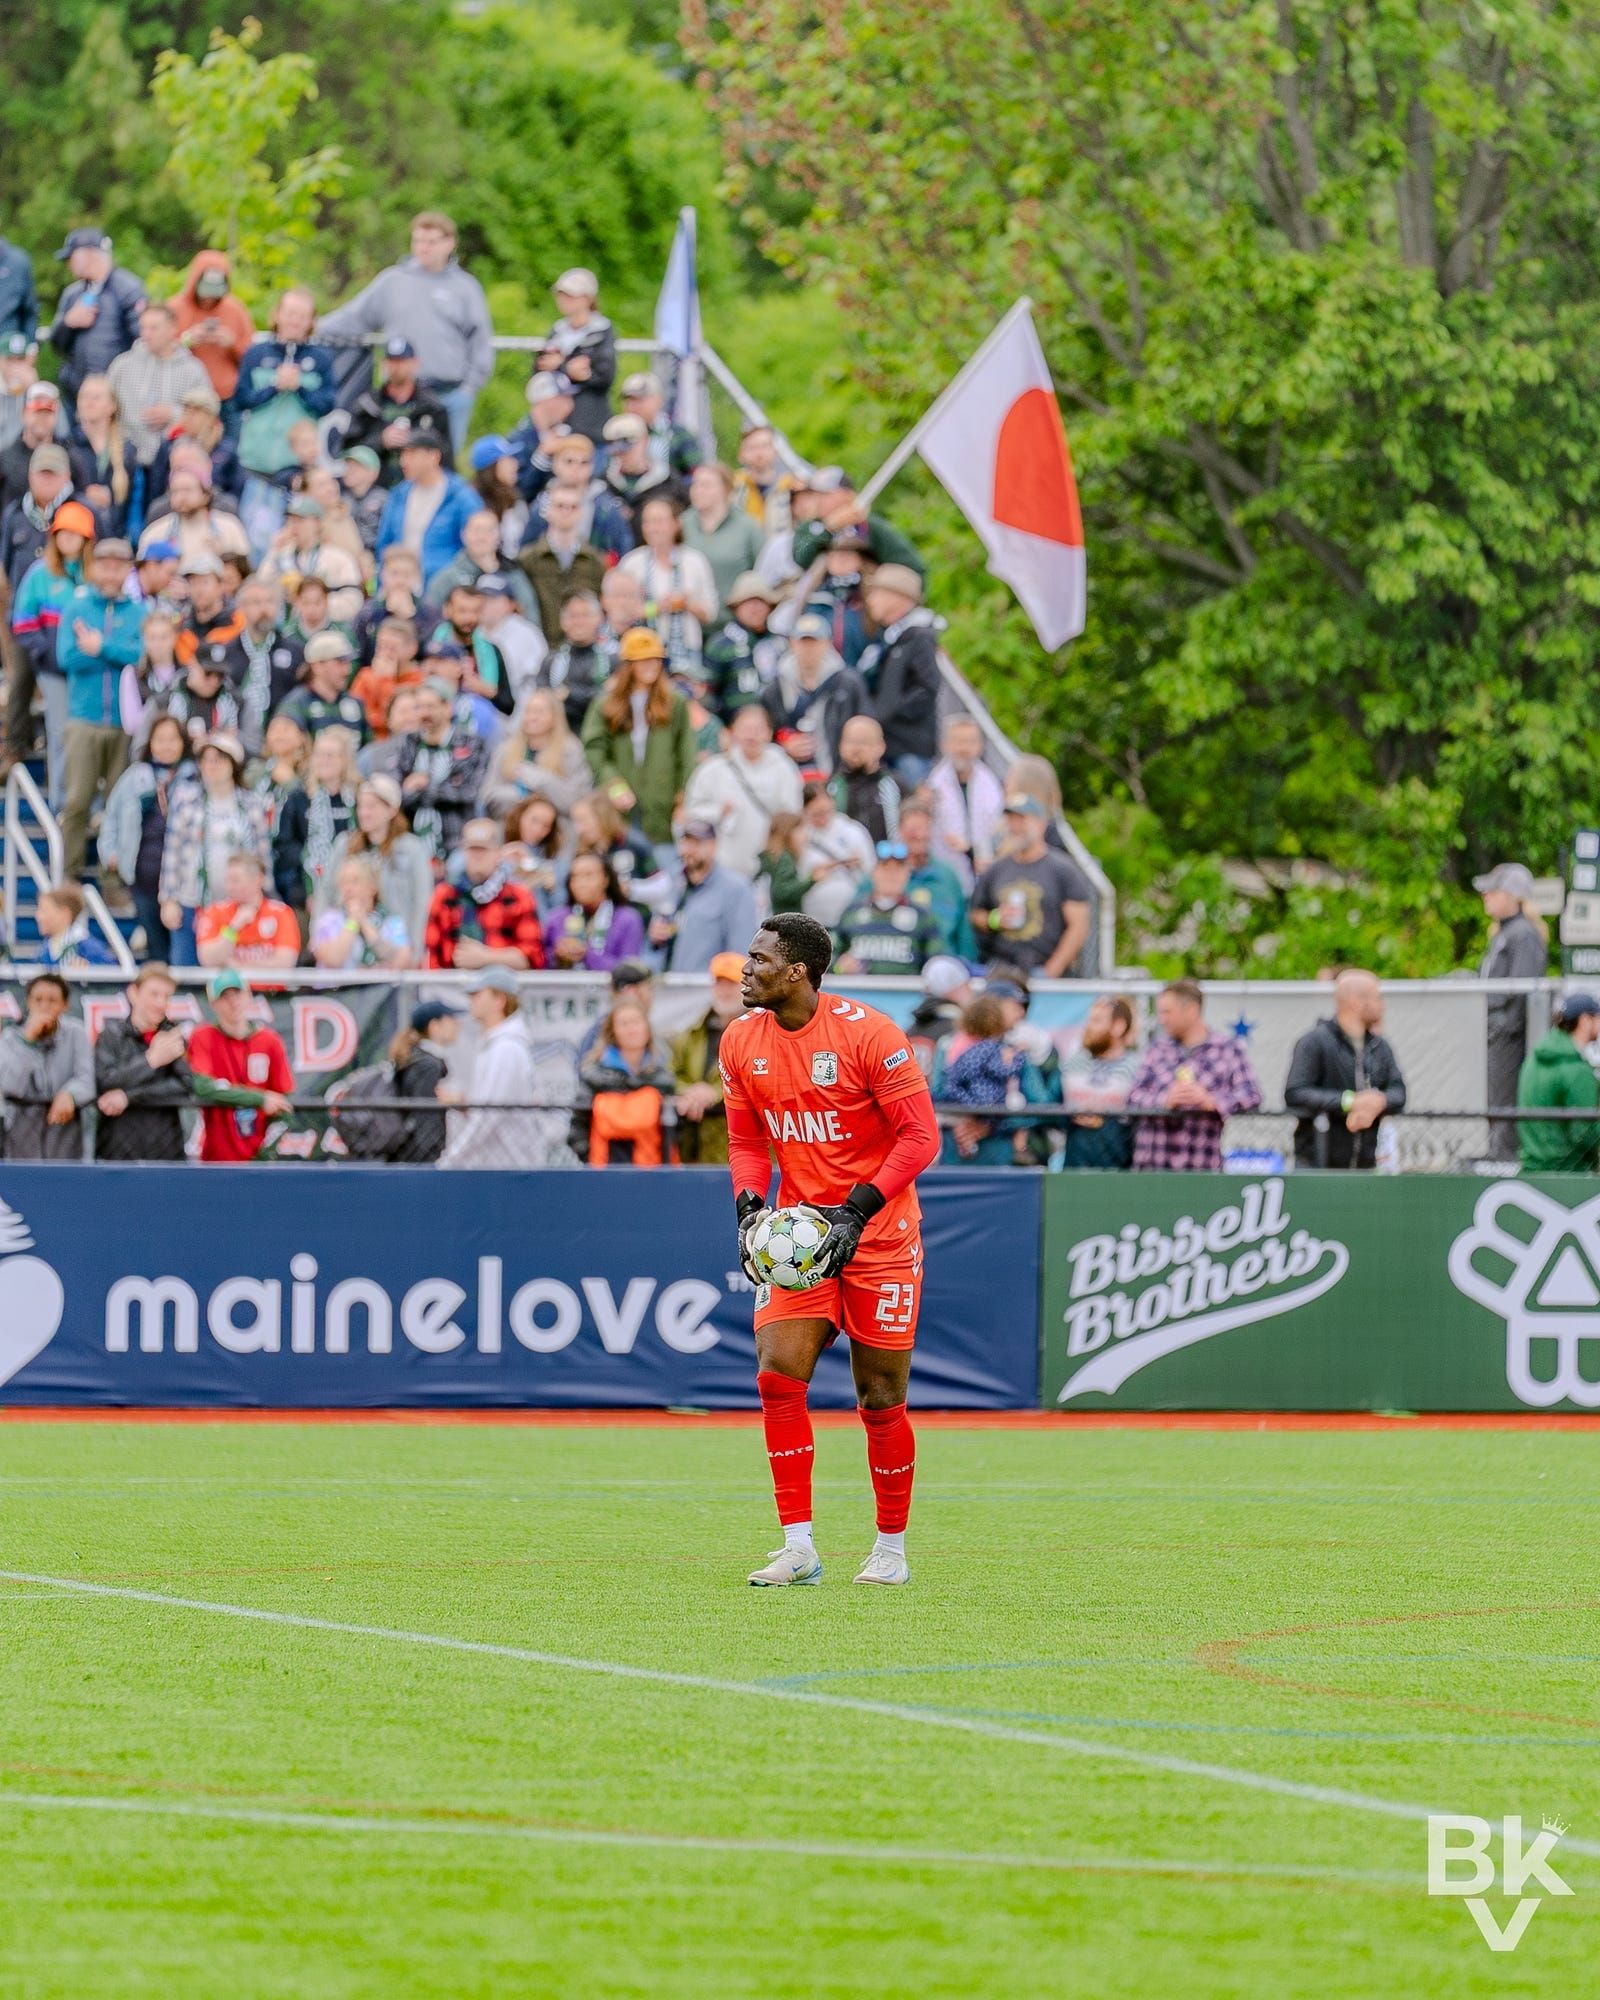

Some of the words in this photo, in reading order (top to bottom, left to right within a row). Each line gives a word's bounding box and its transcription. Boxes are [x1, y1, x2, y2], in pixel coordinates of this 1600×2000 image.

[1063, 1229, 1324, 1357] Brothers
[1066, 1177, 1291, 1299] Bissell
[105, 1252, 722, 1354] mainelove
[875, 1283, 914, 1323] 23
